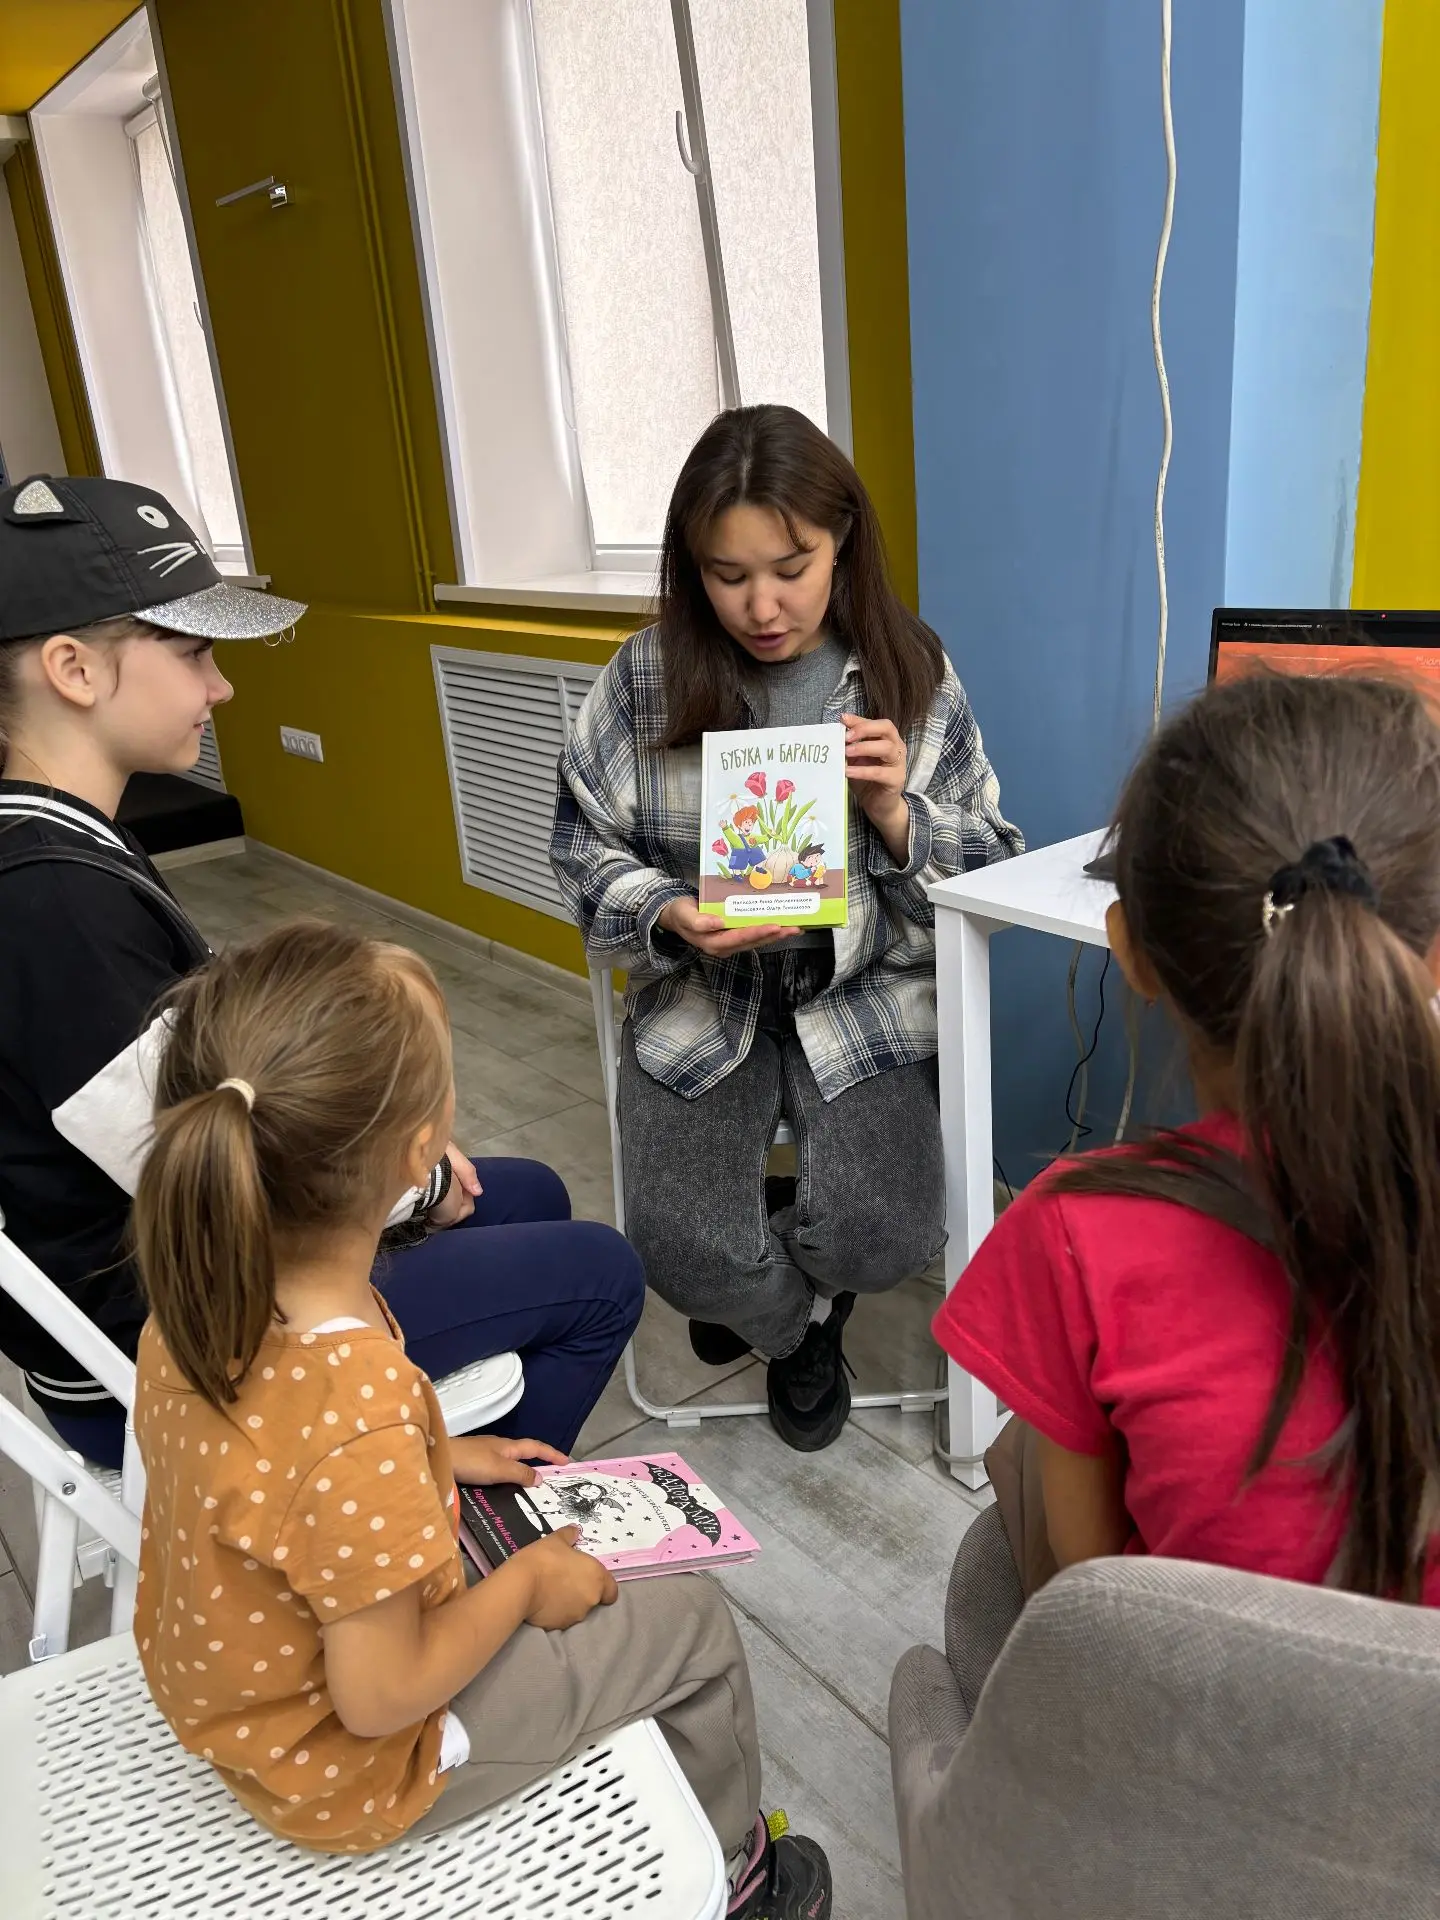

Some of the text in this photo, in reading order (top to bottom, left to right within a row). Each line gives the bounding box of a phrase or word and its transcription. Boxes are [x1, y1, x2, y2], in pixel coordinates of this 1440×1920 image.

[720, 743, 830, 771] БУБУКА и БАРАГОЗ
[651, 1466, 719, 1534] ИЗАДОРА МУН
